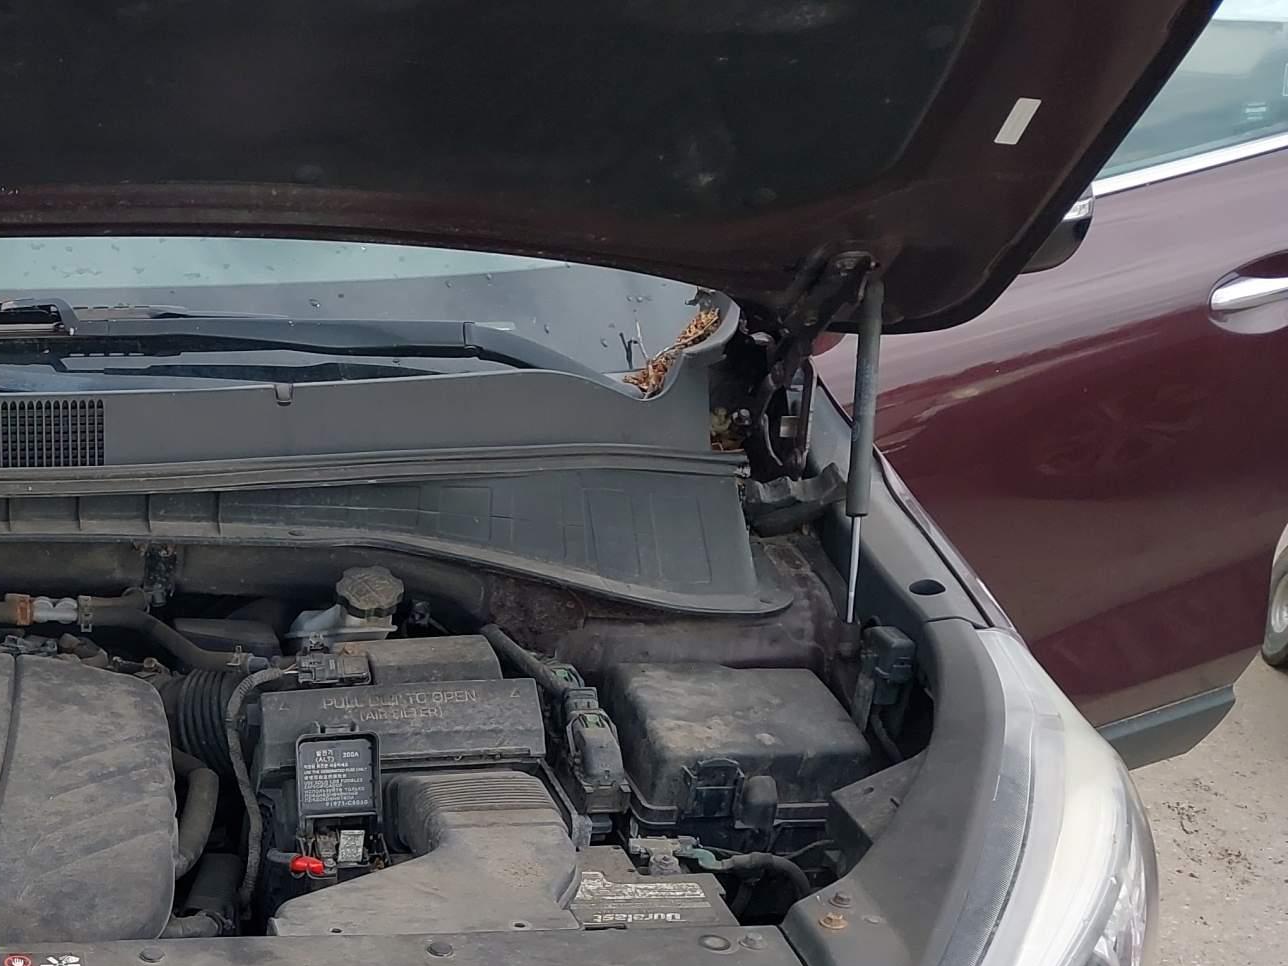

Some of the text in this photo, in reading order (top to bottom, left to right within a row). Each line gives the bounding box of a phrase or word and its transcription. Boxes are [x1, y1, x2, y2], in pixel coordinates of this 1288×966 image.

[323, 689, 477, 710] PULL OUT TO OPEN
[393, 706, 444, 720] FILTER)
[592, 912, 682, 923] Duralast
